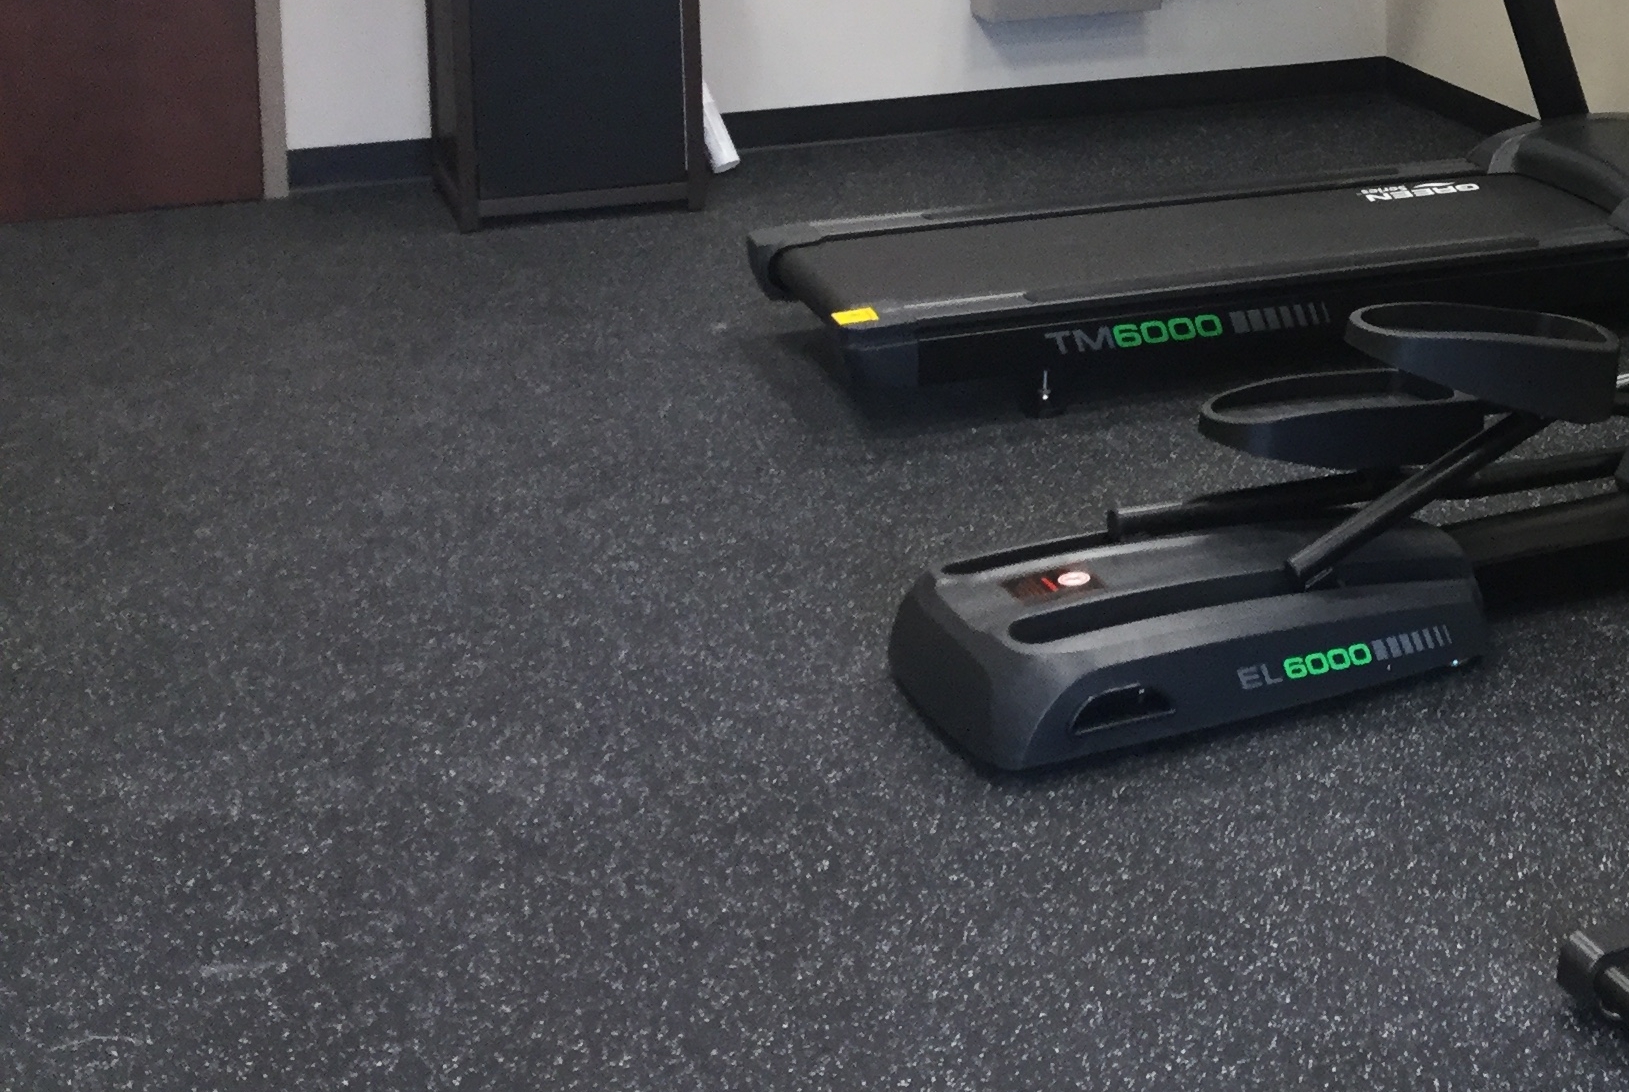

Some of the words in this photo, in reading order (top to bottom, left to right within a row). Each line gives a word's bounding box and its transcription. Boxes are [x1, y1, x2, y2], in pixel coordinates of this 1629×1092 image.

[1365, 183, 1480, 202] GREEN
[1044, 313, 1224, 356] TM6000
[1236, 642, 1373, 690] EL6000
